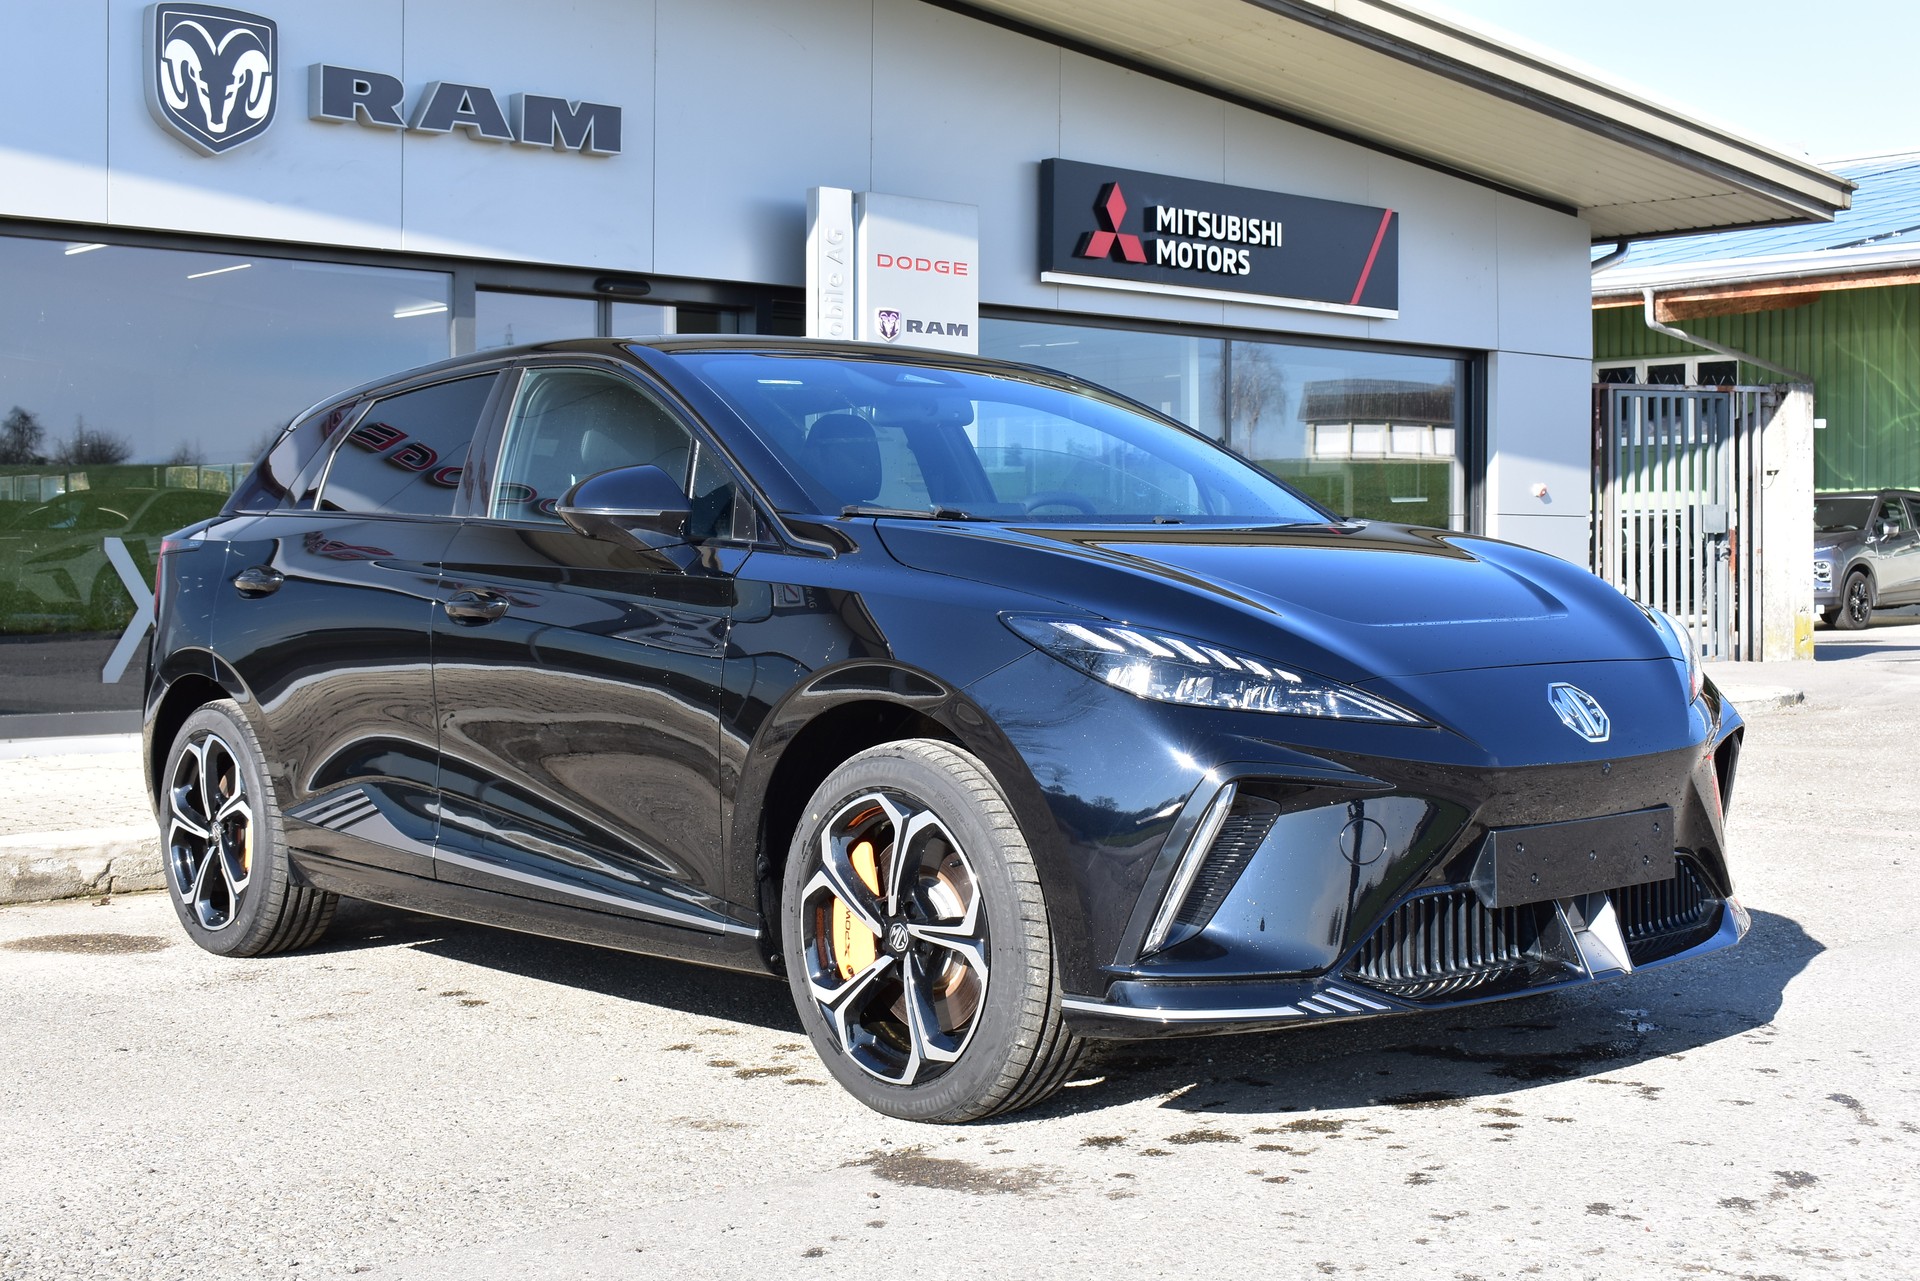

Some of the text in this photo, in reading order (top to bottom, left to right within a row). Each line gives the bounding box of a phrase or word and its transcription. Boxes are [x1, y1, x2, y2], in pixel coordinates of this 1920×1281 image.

[308, 62, 622, 156] RAM
[1156, 205, 1283, 247] MITSUBISHI
[877, 253, 968, 276] DODGE
[1156, 238, 1250, 276] MOTORS
[822, 228, 844, 337] obile AG
[906, 320, 969, 337] RAM
[1548, 682, 1610, 743] MG
[843, 907, 852, 959] XPOW
[890, 923, 908, 952] MG
